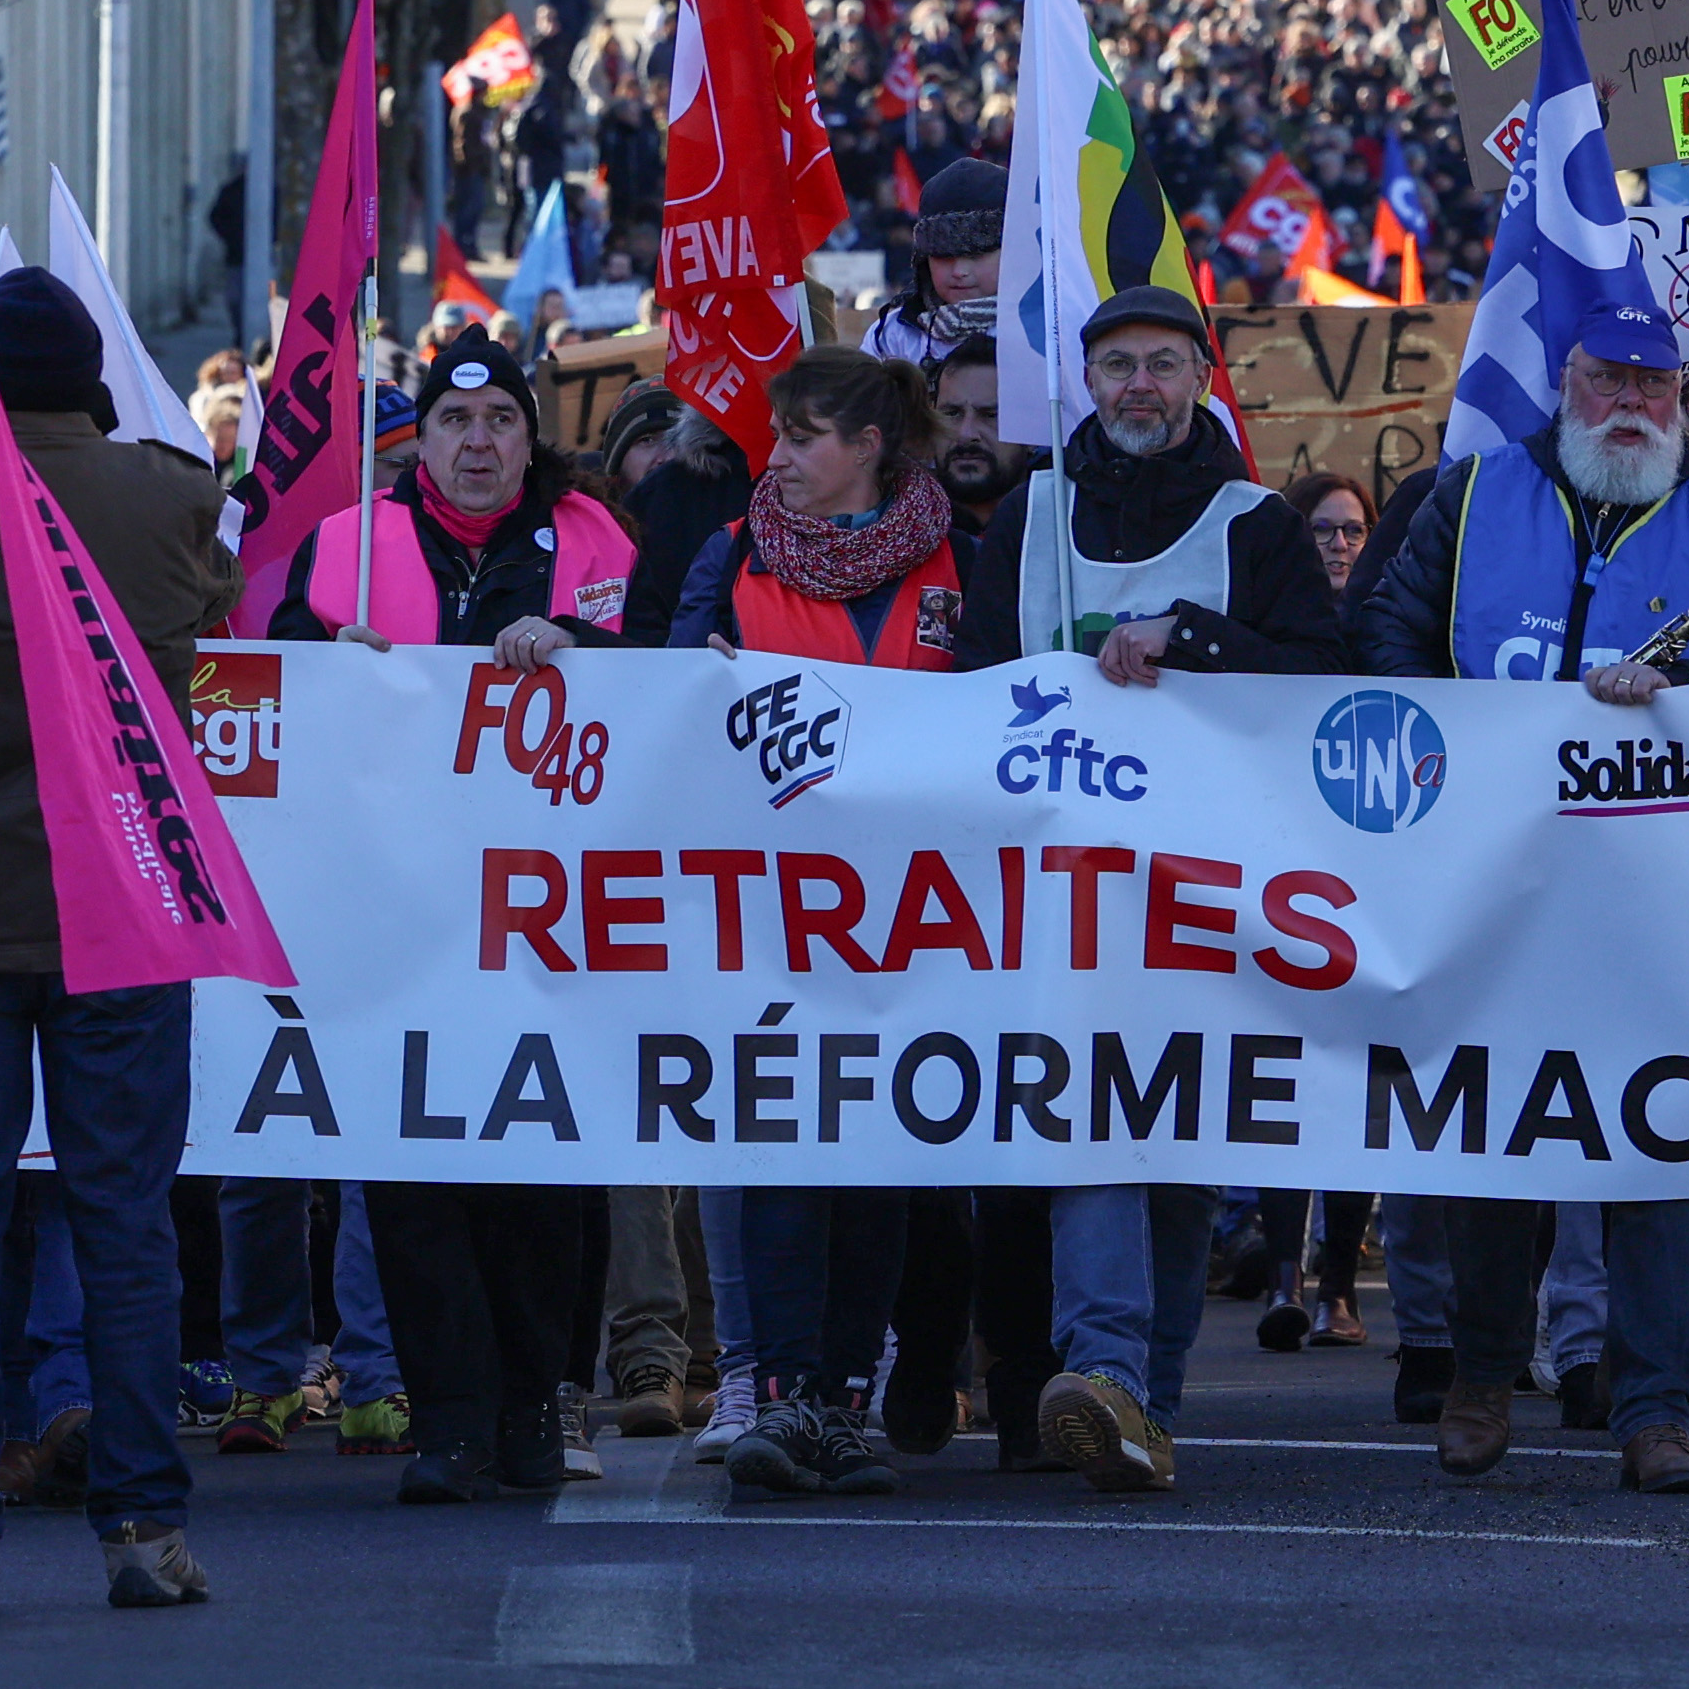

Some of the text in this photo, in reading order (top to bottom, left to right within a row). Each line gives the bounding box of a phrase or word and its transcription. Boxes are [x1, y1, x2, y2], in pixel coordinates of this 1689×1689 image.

[1521, 611, 1567, 634] Syndi
[726, 673, 802, 752] CFE
[759, 706, 842, 786] CGC
[1002, 728, 1045, 744] Syndicat
[996, 727, 1149, 802] cftc
[478, 845, 1359, 992] RETRAITES
[233, 994, 342, 1138] À
[399, 1031, 582, 1144] LA
[636, 1000, 1303, 1146] RÉFORME
